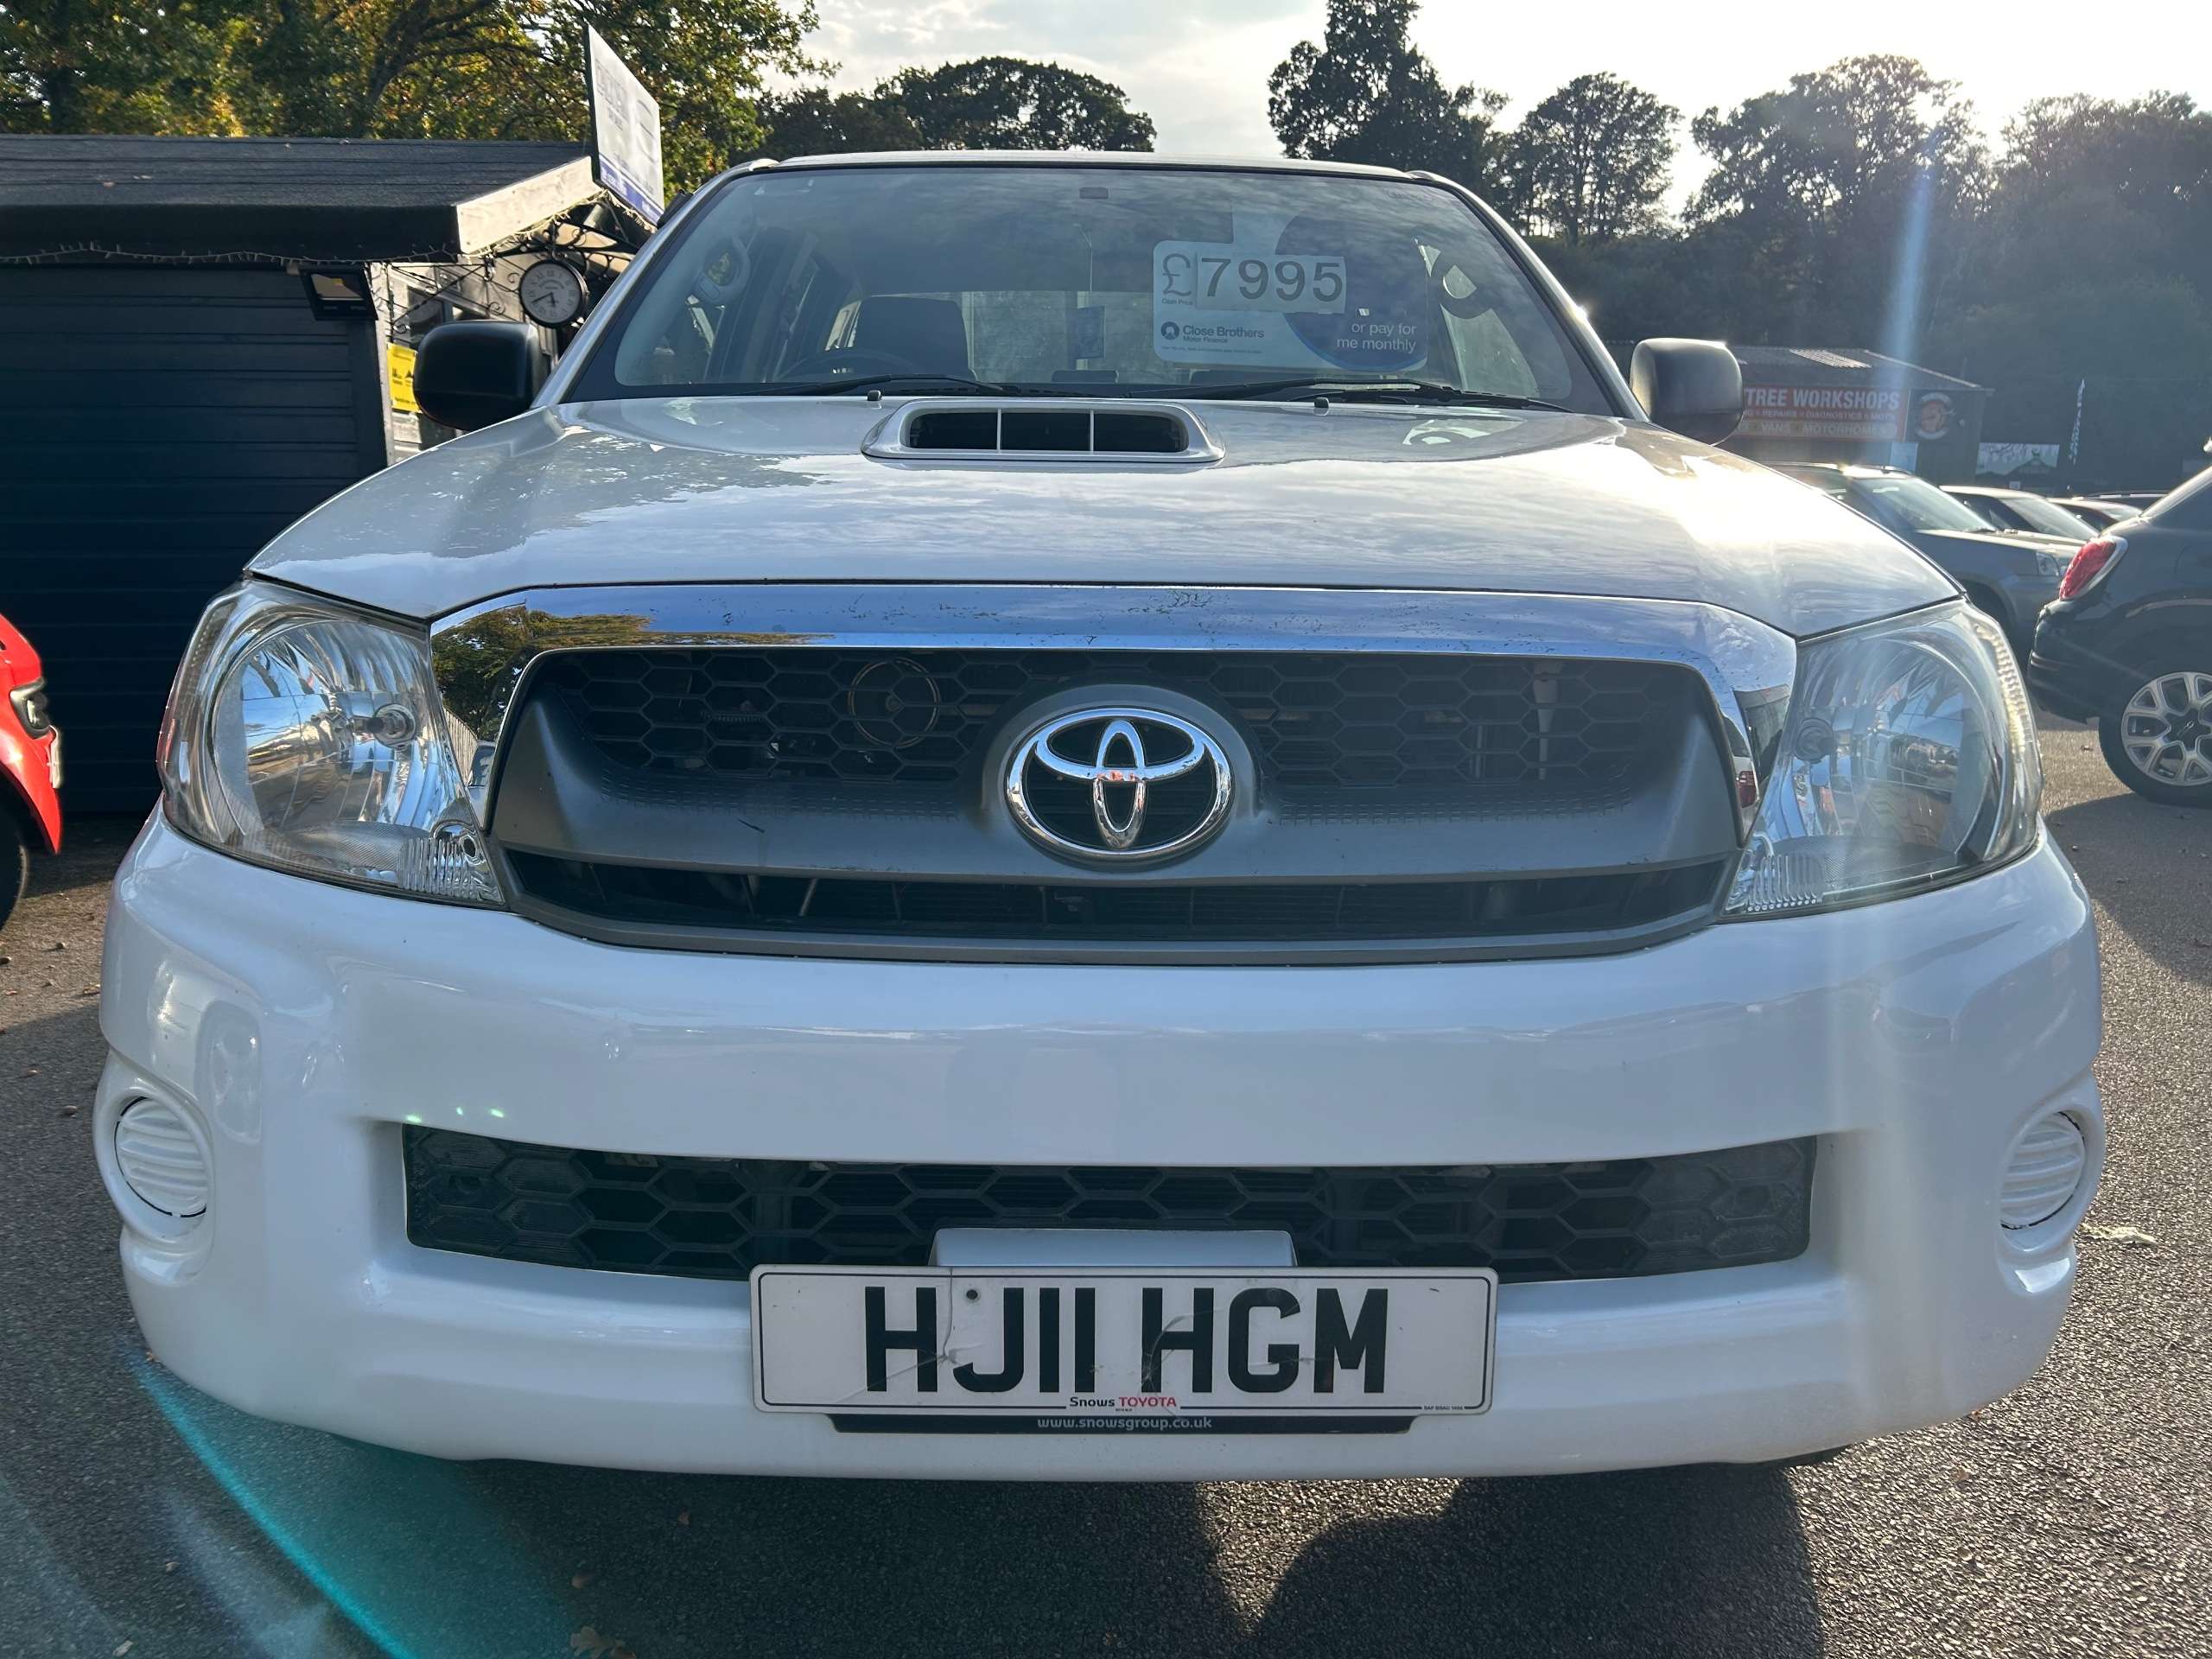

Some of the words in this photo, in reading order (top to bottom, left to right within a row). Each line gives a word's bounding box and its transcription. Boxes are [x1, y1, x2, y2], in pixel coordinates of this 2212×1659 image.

[1182, 325, 1214, 336] Close
[1217, 327, 1265, 339] Brothers
[1351, 323, 1365, 333] or
[1370, 324, 1394, 337] pay
[1399, 323, 1417, 335] for
[1337, 338, 1358, 349] me
[1362, 338, 1417, 354] monthly
[1793, 389, 1901, 410] WORKSHOPS
[865, 1286, 1096, 1393] HJ11
[1141, 1287, 1389, 1394] HGM
[1070, 1396, 1115, 1408] Snows
[1119, 1396, 1177, 1408] TOYOTA
[1038, 1416, 1212, 1431] www.snowsgroup.co.uk
